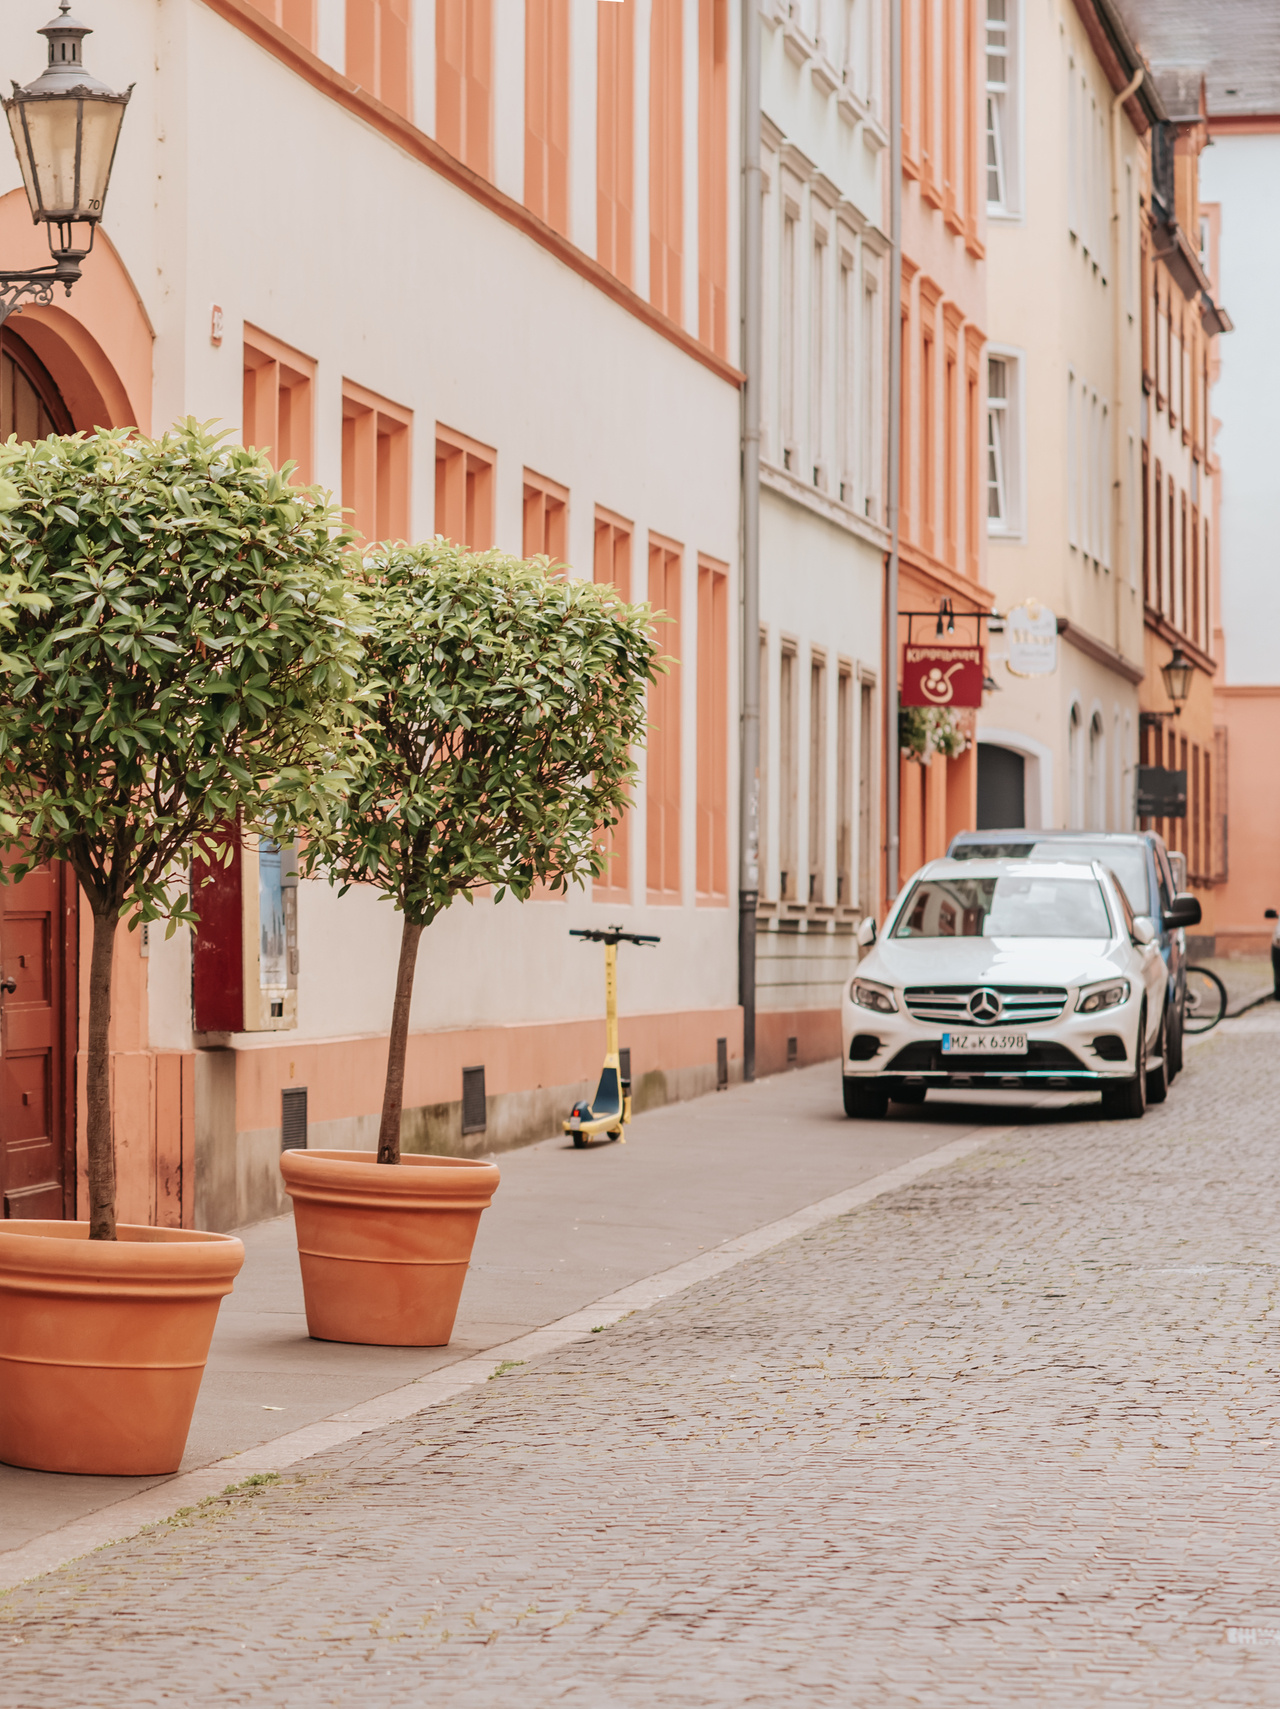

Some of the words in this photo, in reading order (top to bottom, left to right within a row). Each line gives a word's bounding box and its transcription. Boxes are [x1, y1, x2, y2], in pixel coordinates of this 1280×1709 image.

[88, 199, 100, 210] 70
[951, 1036, 968, 1049] MZ
[978, 1036, 986, 1049] K
[990, 1036, 1024, 1049] 6398
